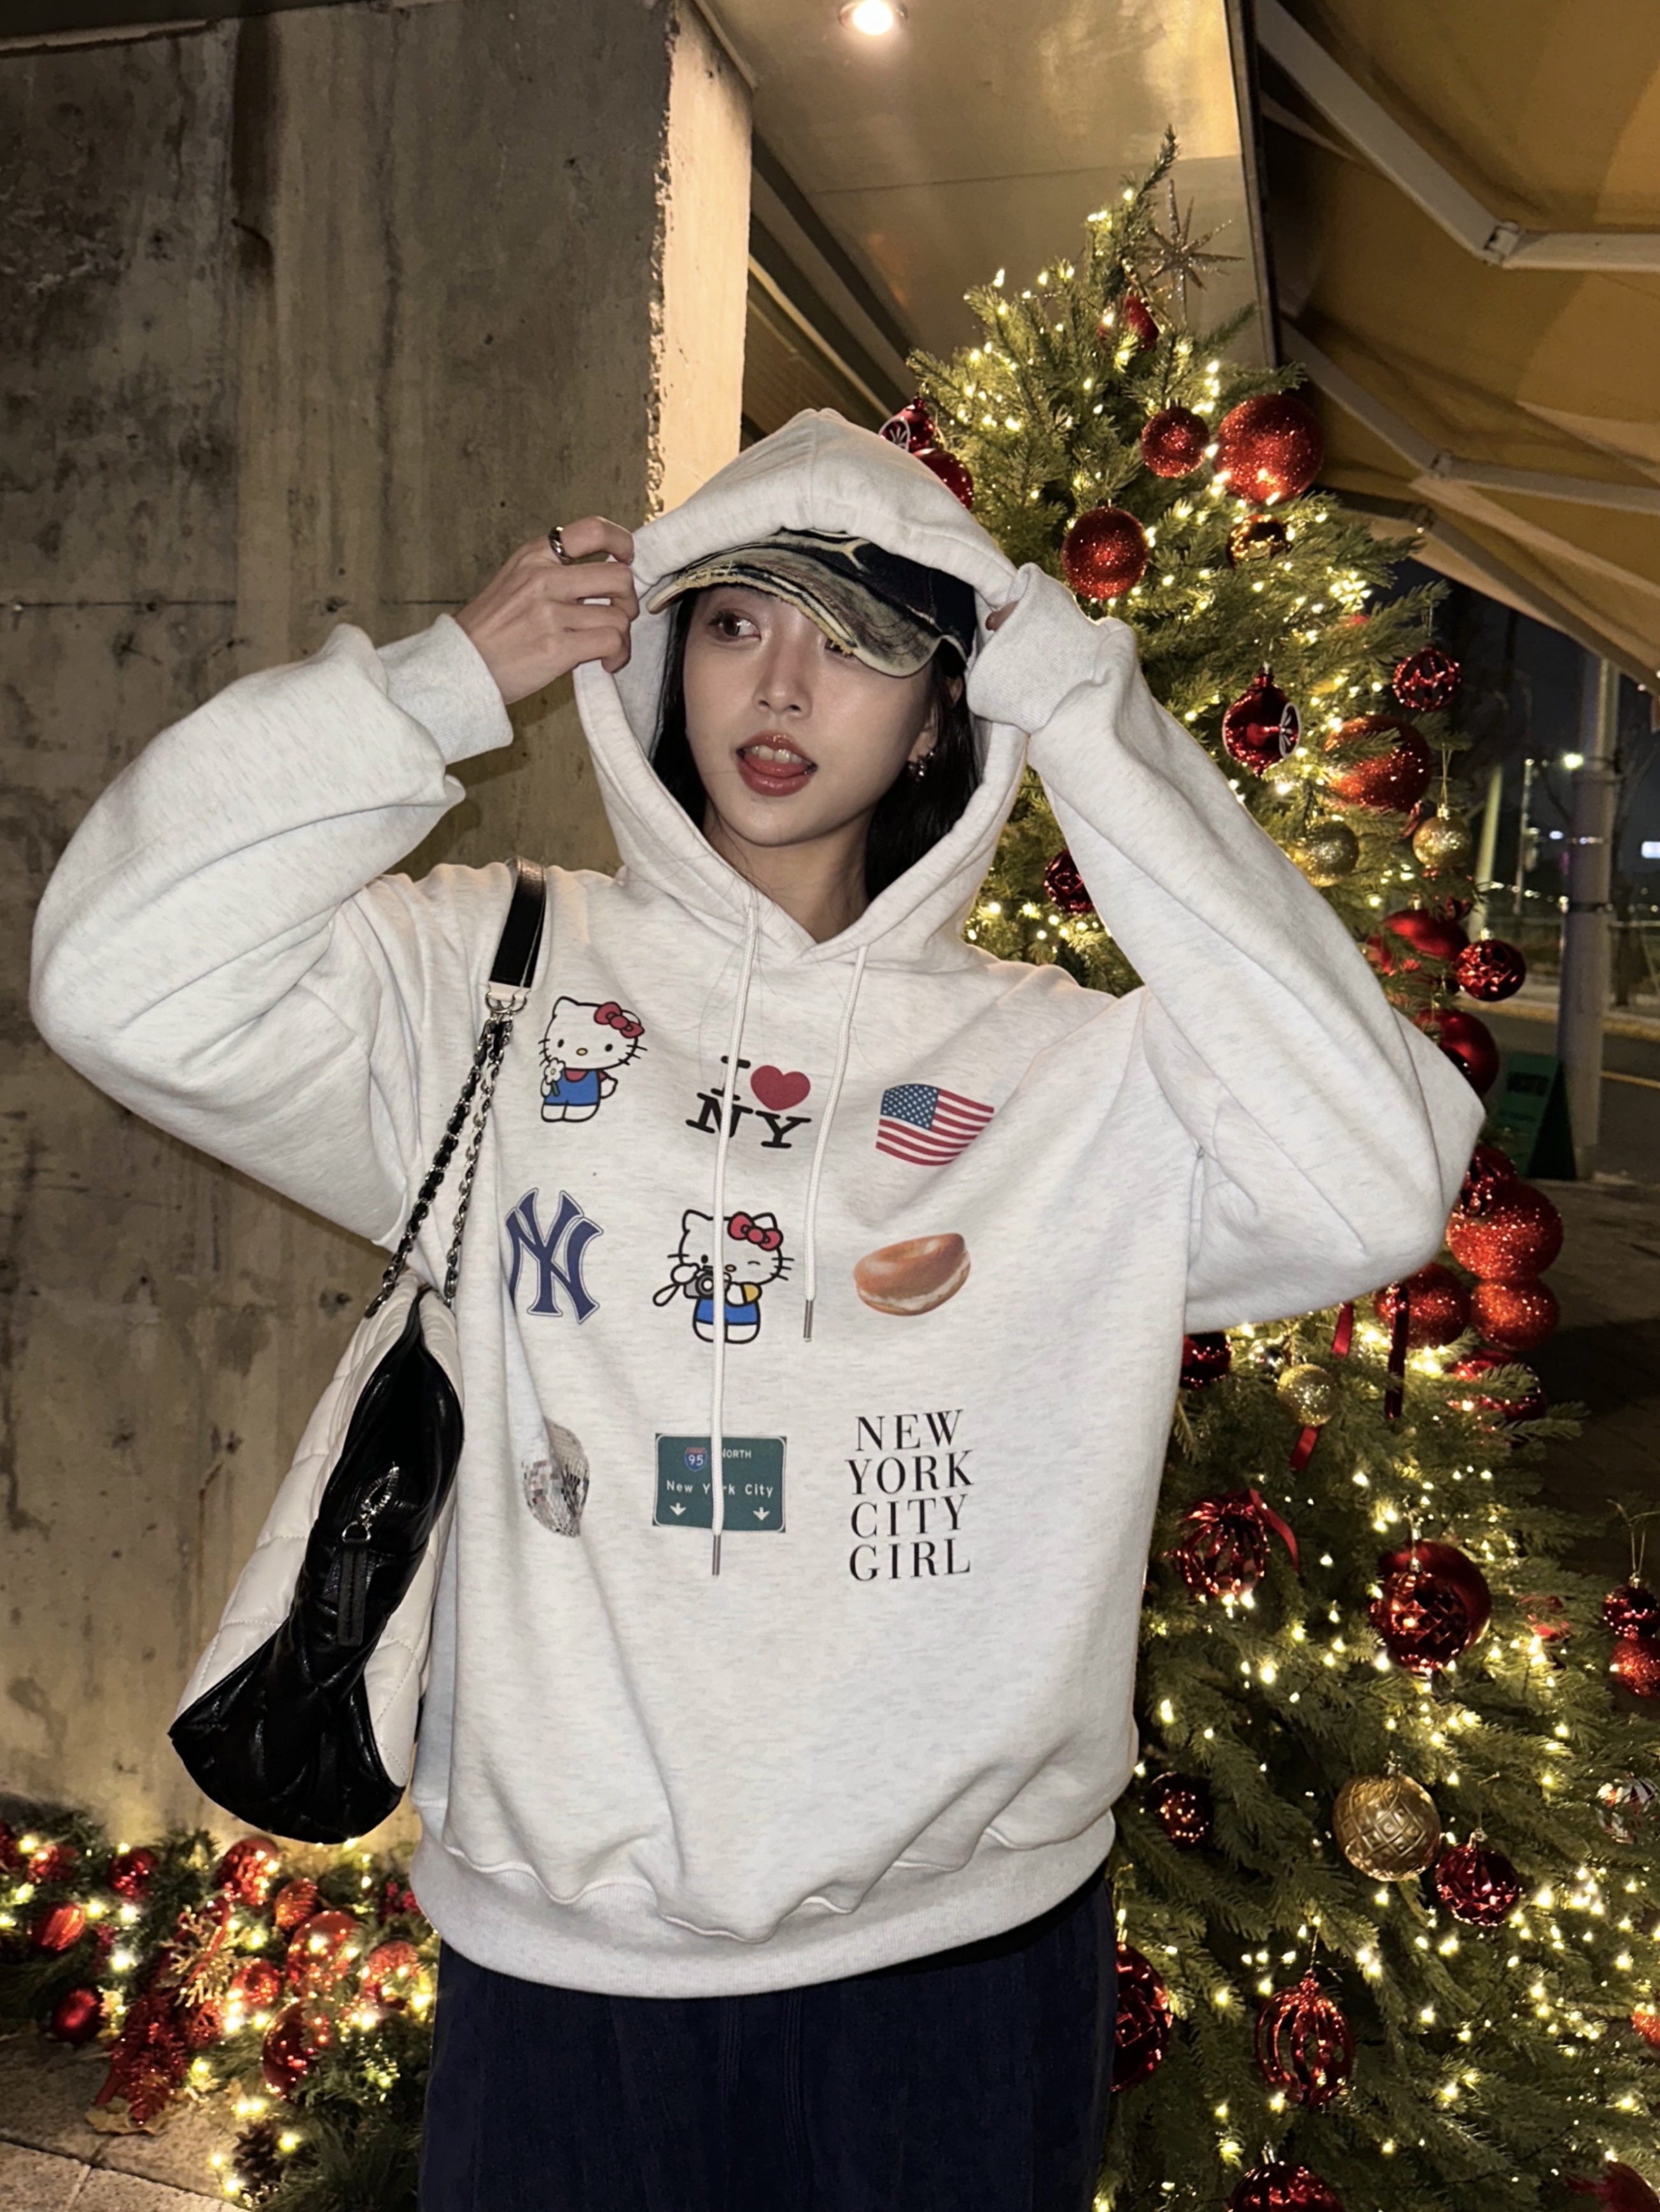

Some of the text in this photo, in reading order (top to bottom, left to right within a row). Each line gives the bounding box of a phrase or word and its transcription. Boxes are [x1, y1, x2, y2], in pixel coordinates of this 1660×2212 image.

[685, 1092, 812, 1149] NY
[505, 1187, 604, 1325] NY
[854, 1409, 964, 1452] NEW
[688, 1447, 751, 1466] 95 NORTH
[844, 1449, 975, 1495] YORK
[666, 1480, 774, 1498] New Yk City
[850, 1493, 968, 1538] CITY
[849, 1537, 971, 1582] GIRL
